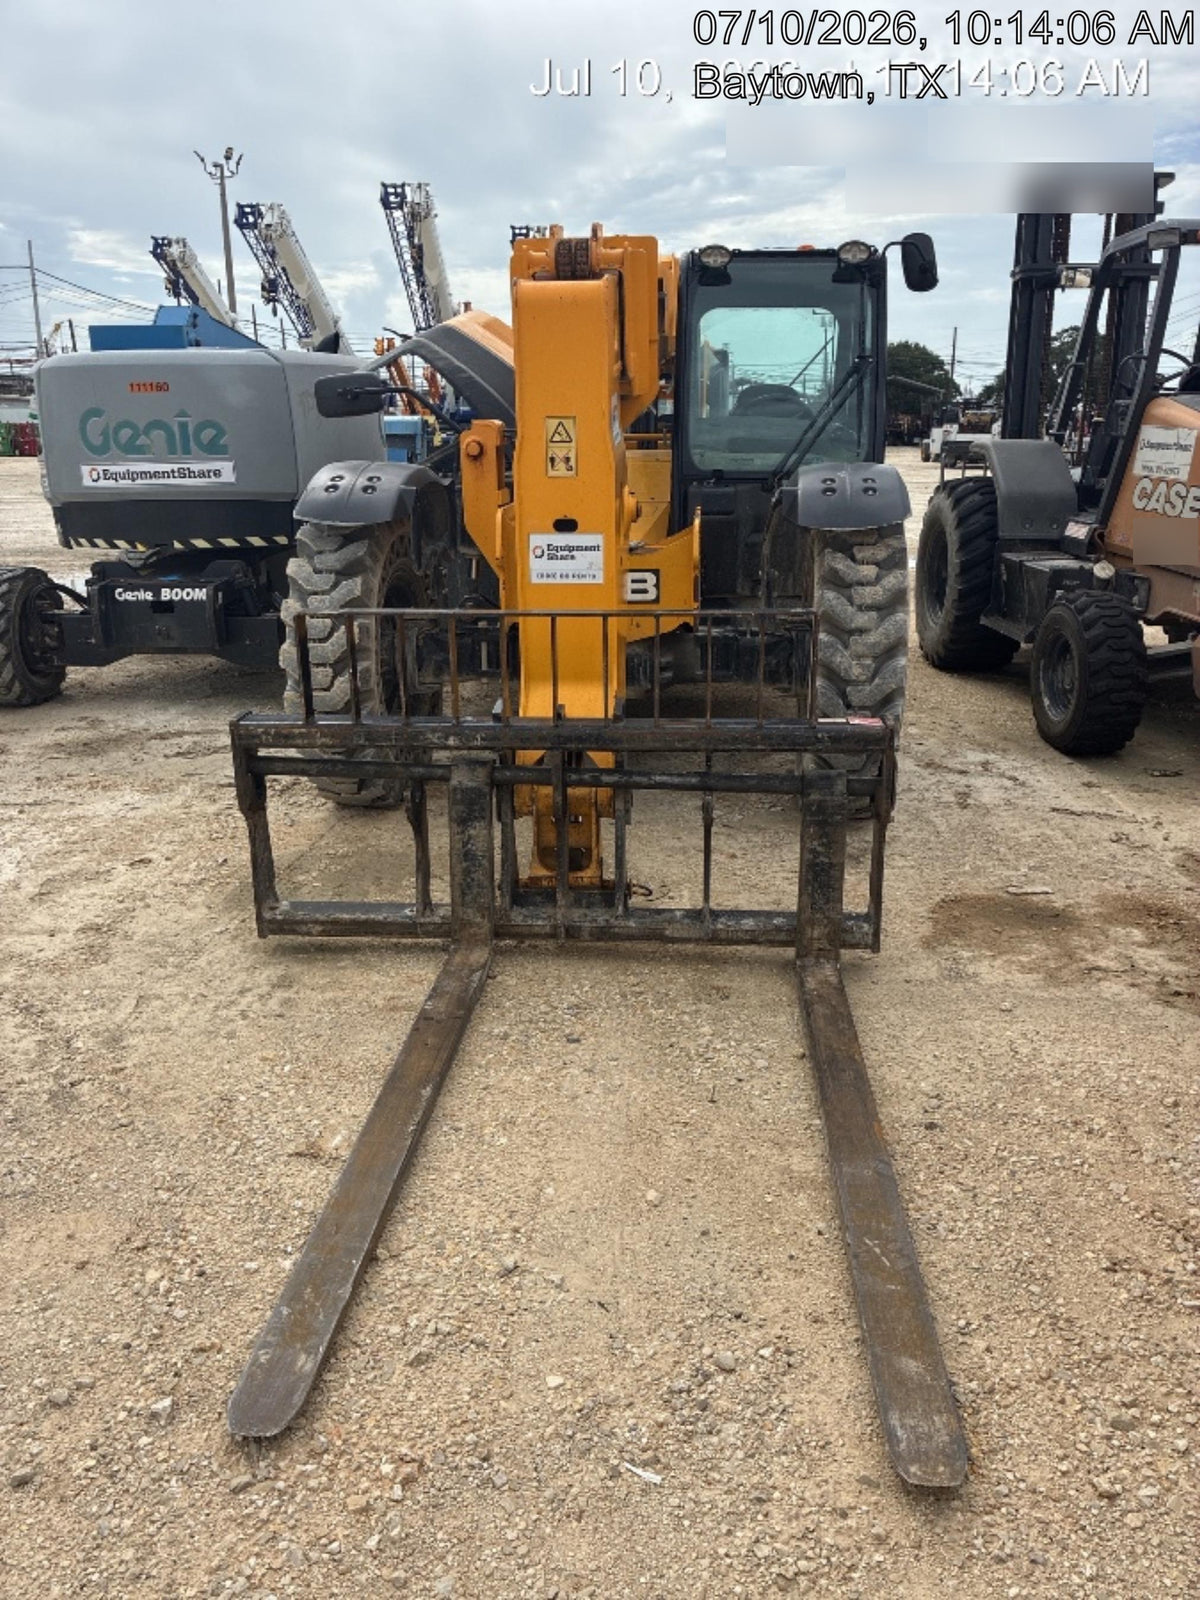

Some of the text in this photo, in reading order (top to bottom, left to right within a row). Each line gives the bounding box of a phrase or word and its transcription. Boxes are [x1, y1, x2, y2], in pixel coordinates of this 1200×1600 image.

[79, 407, 230, 457] Genie
[102, 467, 223, 483] EquipmentShare
[1132, 477, 1200, 519] CASE
[547, 543, 601, 553] Equipment
[114, 587, 208, 601] Genie BOOM
